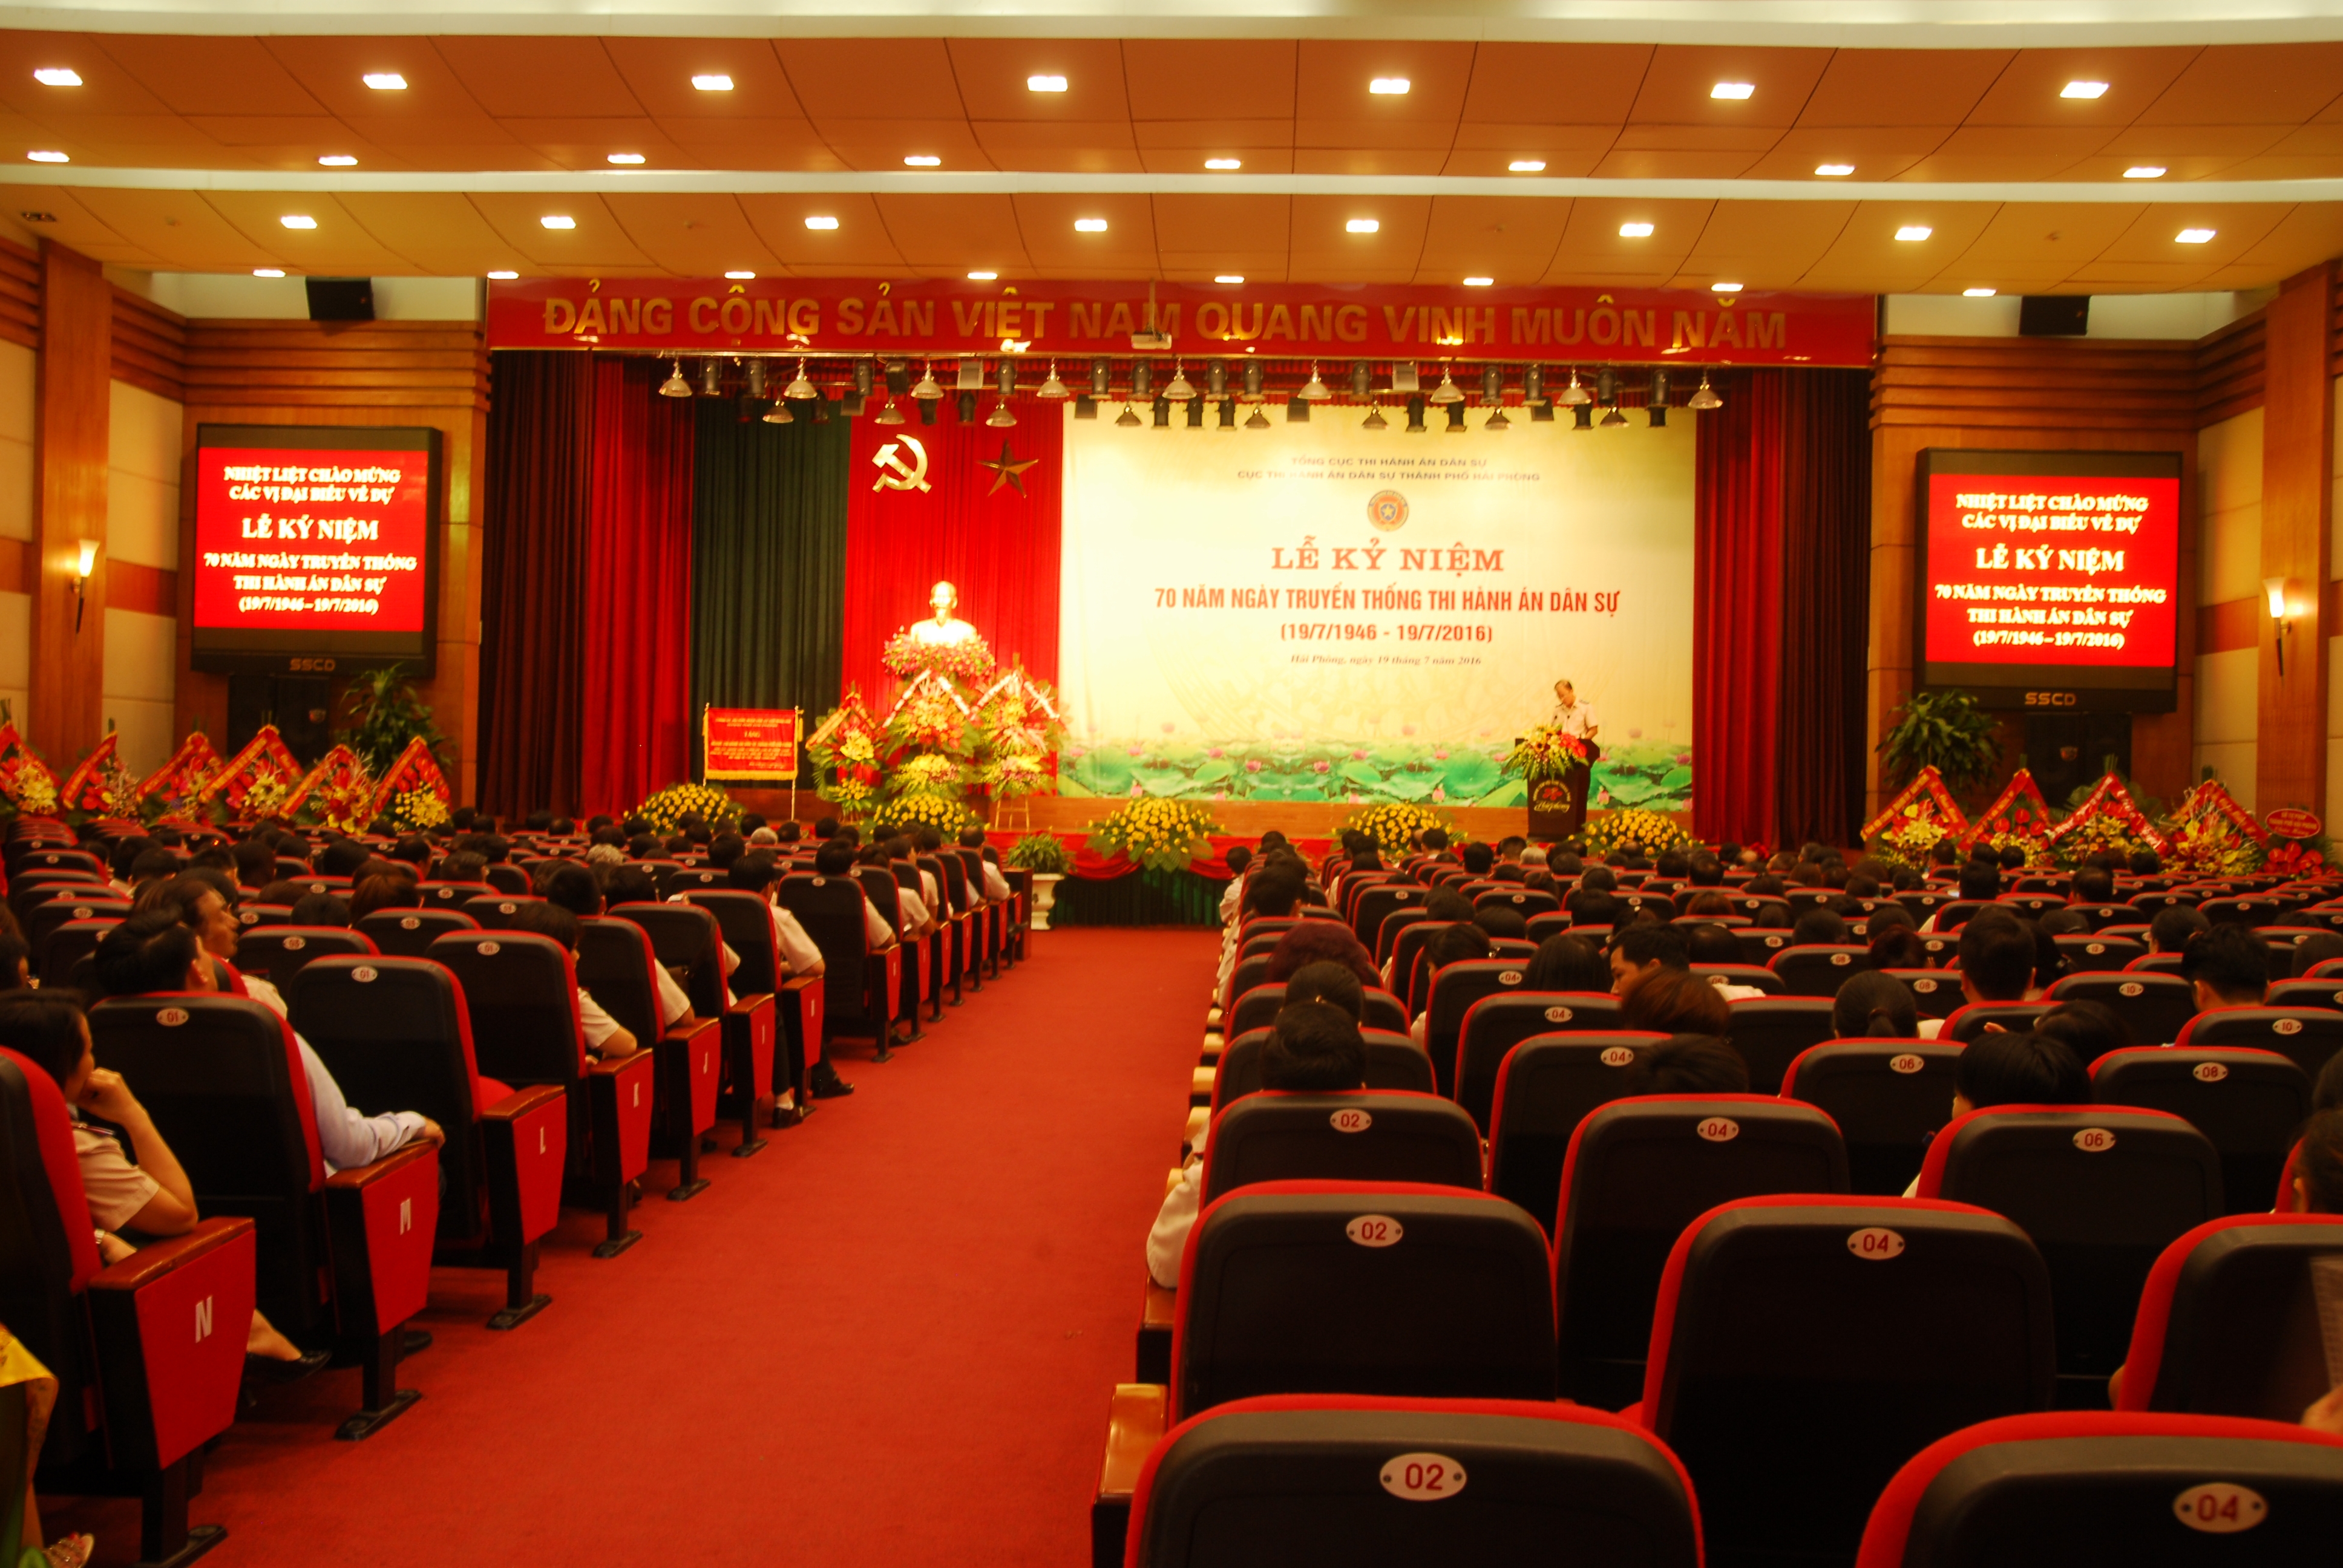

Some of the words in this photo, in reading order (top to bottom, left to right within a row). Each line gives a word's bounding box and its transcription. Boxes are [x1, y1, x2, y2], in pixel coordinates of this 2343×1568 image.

[543, 279, 673, 335] ĐẢNG
[837, 282, 934, 336] SẢN
[1070, 302, 1180, 339] NAM
[1195, 302, 1368, 342] QUANG
[1383, 306, 1495, 344] VINH
[1512, 295, 1656, 347] MUÔN
[1672, 298, 1785, 349] NĂM
[1329, 458, 1353, 468] CỤC
[1358, 458, 1376, 466] THI
[1380, 457, 1415, 466] HÀNH
[1419, 457, 1436, 466] ÁN
[1440, 457, 1466, 466] DÂN
[1470, 459, 1487, 469] SỰ
[224, 465, 270, 484] NHIỆT
[272, 466, 308, 485] LIỆT
[309, 466, 353, 483] CHÀO
[1238, 471, 1262, 481] CỤC
[1267, 471, 1285, 479] THI
[1328, 469, 1344, 479] ÁN
[1349, 469, 1374, 479] DÂN
[1379, 471, 1395, 482] SỰ
[1399, 470, 1440, 480] THÀNH
[1444, 469, 1469, 480] PHỐ
[229, 483, 262, 500] CÁC
[263, 486, 281, 503] VỊ
[1956, 492, 2007, 512] NHIỆT
[2008, 493, 2048, 513] LIỆT
[2048, 493, 2097, 512] CHÀO
[318, 517, 379, 544] NIỆM
[1962, 512, 1996, 529] CÁC
[1997, 514, 2018, 532] VỊ
[203, 553, 220, 567] 70
[220, 552, 257, 568] NĂM
[257, 552, 301, 569] NGÀY
[1271, 535, 1319, 570] LỄ
[1331, 537, 1386, 570] KỶ
[1400, 541, 1504, 577] NIỆM
[2058, 547, 2125, 576] NIỆM
[233, 575, 263, 590] THI
[262, 573, 307, 591] HÀNH
[307, 574, 329, 591] ÁN
[329, 575, 362, 592] DÂN
[364, 576, 387, 595] SỰ
[1935, 584, 1953, 599] 70
[1953, 584, 1991, 600] NĂM
[1992, 583, 2040, 601] NGÀY
[1155, 588, 1176, 608] 70
[1182, 583, 1225, 609] NĂM
[1231, 583, 1280, 609] NGÀY
[1362, 582, 1421, 610] THỐNG
[1428, 590, 1455, 610] THI
[1462, 586, 1512, 611] HÀNH
[1518, 587, 1543, 612] ÁN
[1550, 587, 1587, 612] DÂN
[1594, 589, 1620, 618] SỰ
[1967, 607, 1997, 623] THI
[1998, 606, 2046, 624] HÀNH
[2046, 607, 2071, 624] ÁN
[2072, 607, 2107, 626] DÂN
[2109, 609, 2134, 629] SỰ
[1281, 623, 1377, 641] (19/7/1946
[1397, 624, 1493, 644] 19/7/2016)
[289, 658, 336, 671] SSCD
[1378, 656, 1389, 665] 19
[1423, 656, 1430, 665] 7
[1457, 656, 1483, 665] 2016
[2025, 692, 2077, 706] SSCD
[1505, 973, 1517, 982] 04
[2126, 985, 2135, 994] 10
[167, 1012, 179, 1023] 01
[1551, 1010, 1565, 1019] 04
[2282, 1021, 2293, 1032] 10
[1610, 1050, 1627, 1063] 04
[1899, 1057, 1915, 1070] 06
[2202, 1067, 2219, 1079] 08
[1340, 1113, 1360, 1128] 02
[1708, 1122, 1728, 1138] 04
[2084, 1132, 2104, 1148] 06
[400, 1197, 411, 1235] M
[1361, 1221, 1388, 1241] 02
[1862, 1233, 1890, 1253] 04
[195, 1295, 213, 1344] N
[1404, 1463, 1444, 1491] 02
[2197, 1494, 2240, 1523] 04
